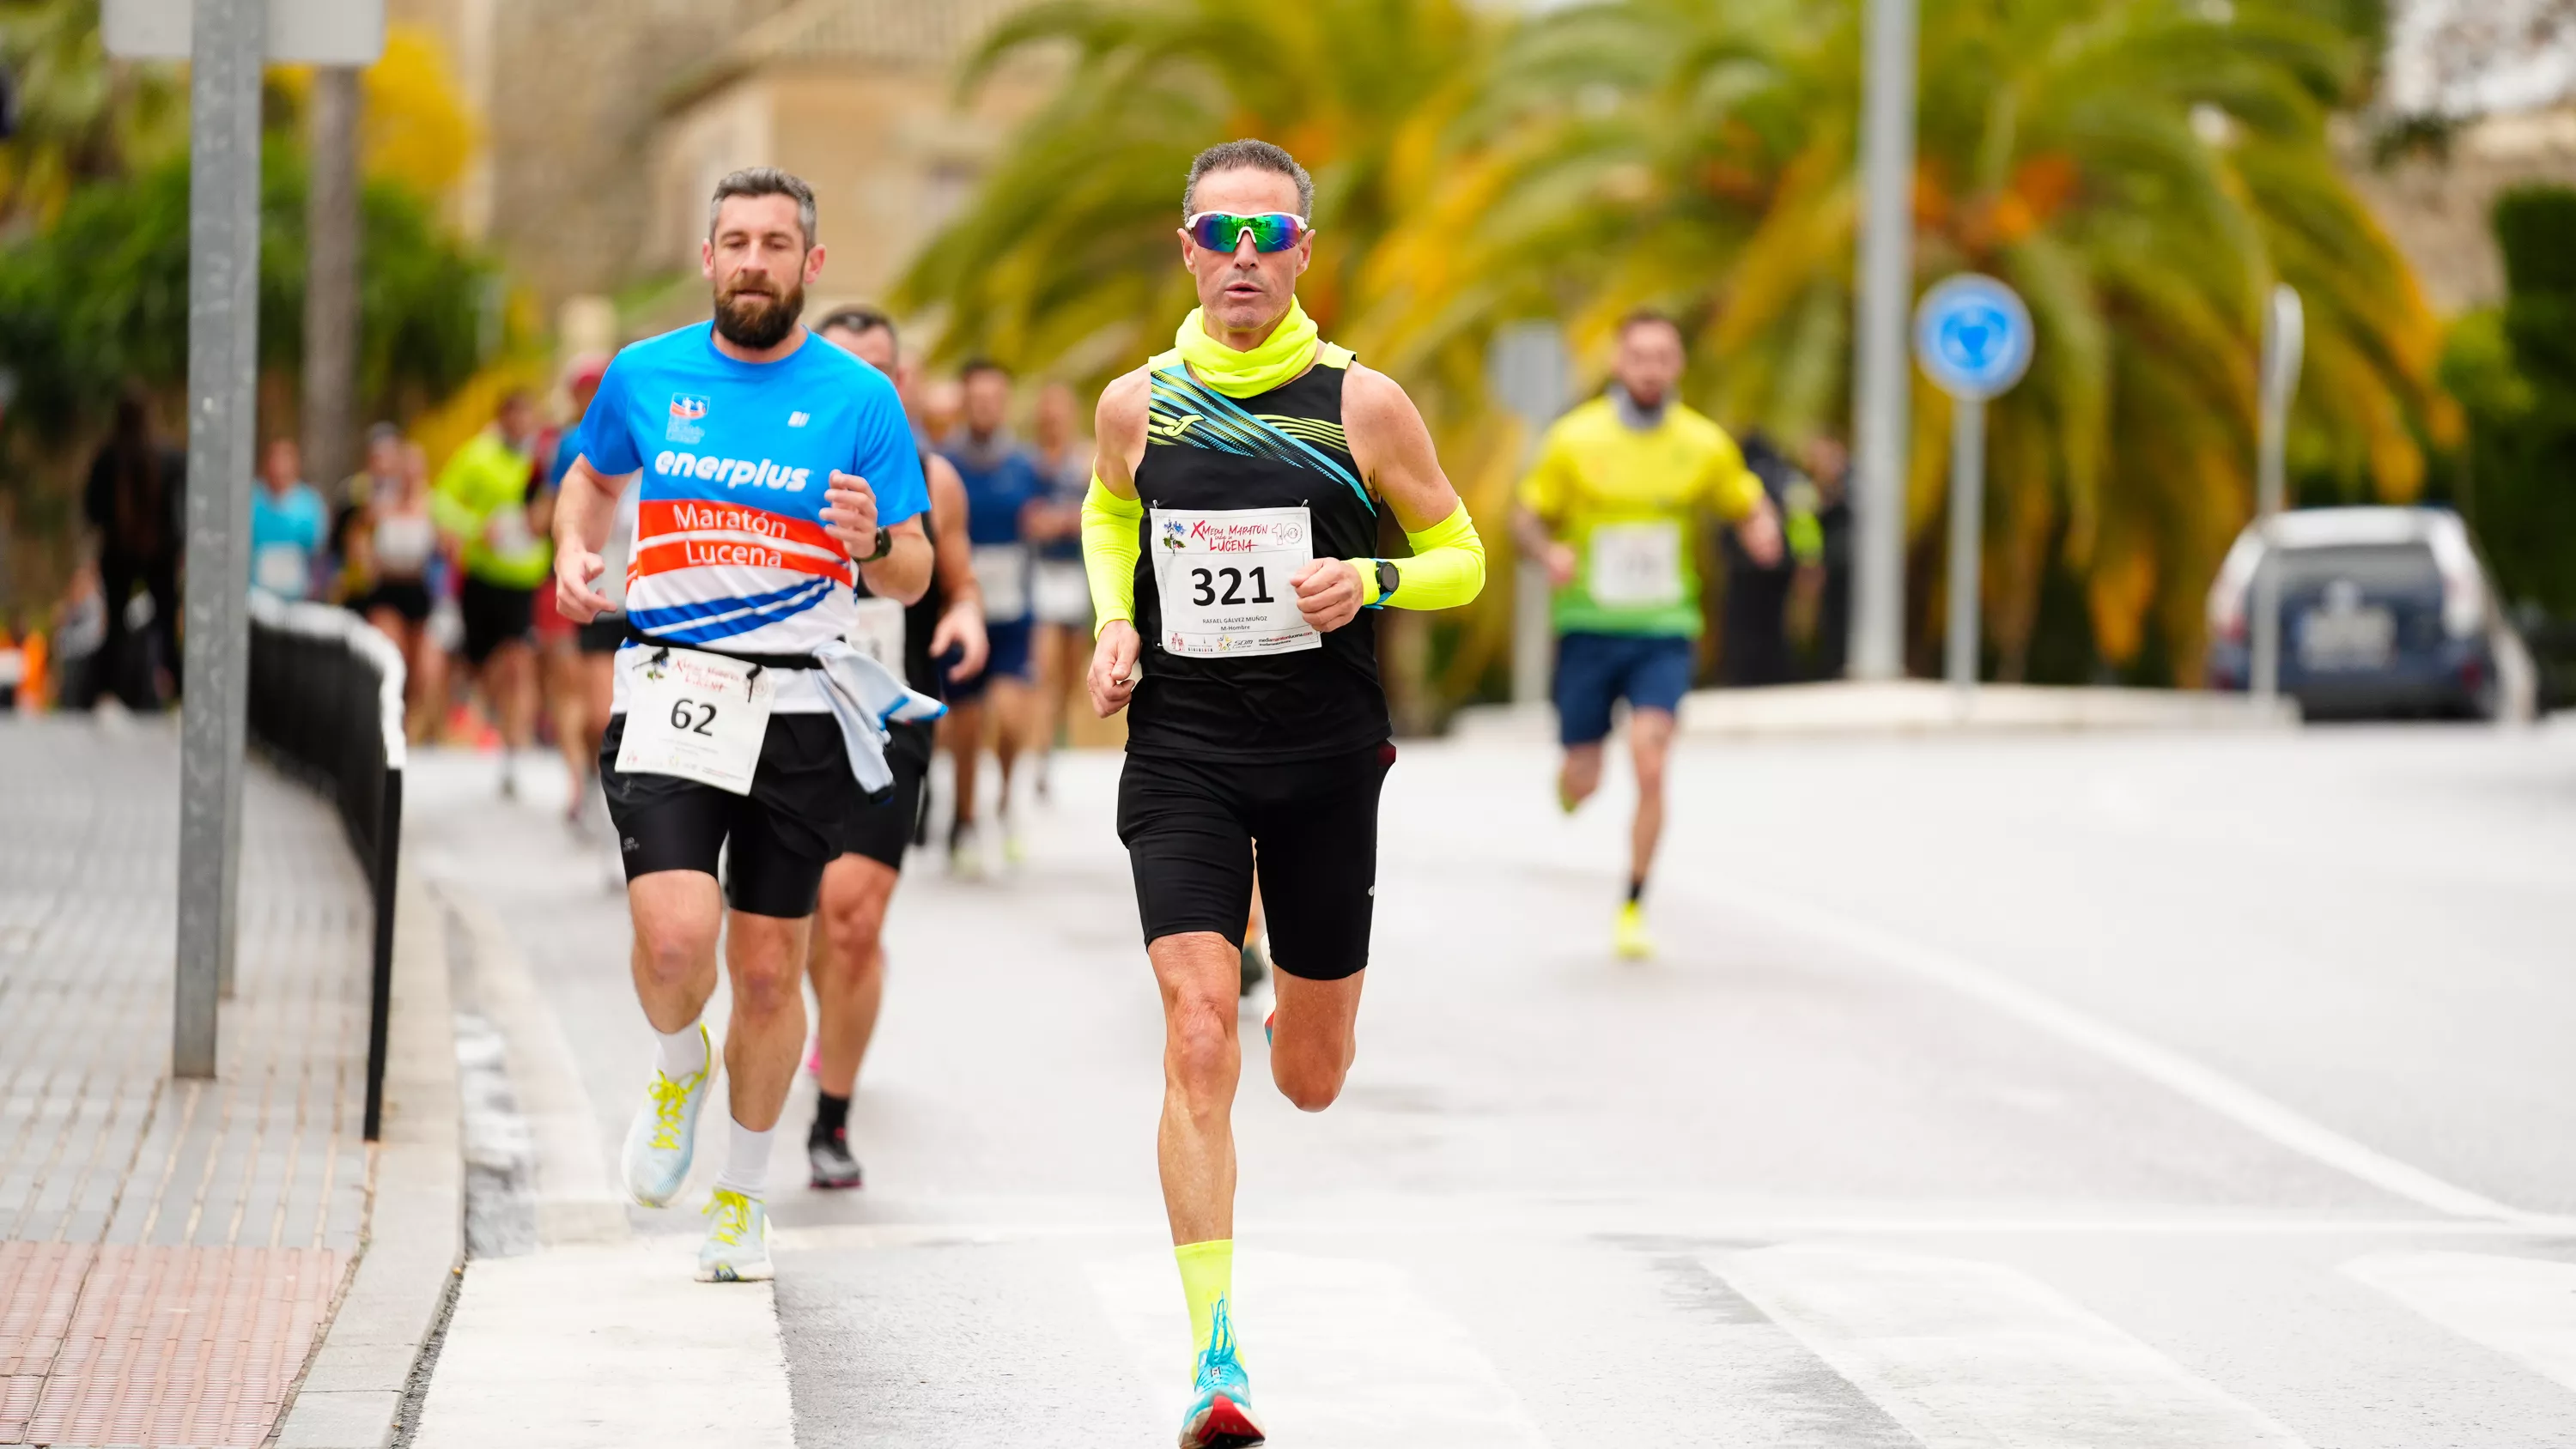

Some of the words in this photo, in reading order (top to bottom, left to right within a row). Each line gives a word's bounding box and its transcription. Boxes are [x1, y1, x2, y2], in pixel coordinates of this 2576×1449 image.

[655, 451, 810, 492] enerplus
[673, 503, 787, 538] Maratón
[1229, 524, 1268, 537] MARATÓN
[686, 540, 782, 568] Lucena
[1210, 537, 1260, 552] LUCENA
[1191, 567, 1274, 607] 321
[671, 698, 717, 737] 62
